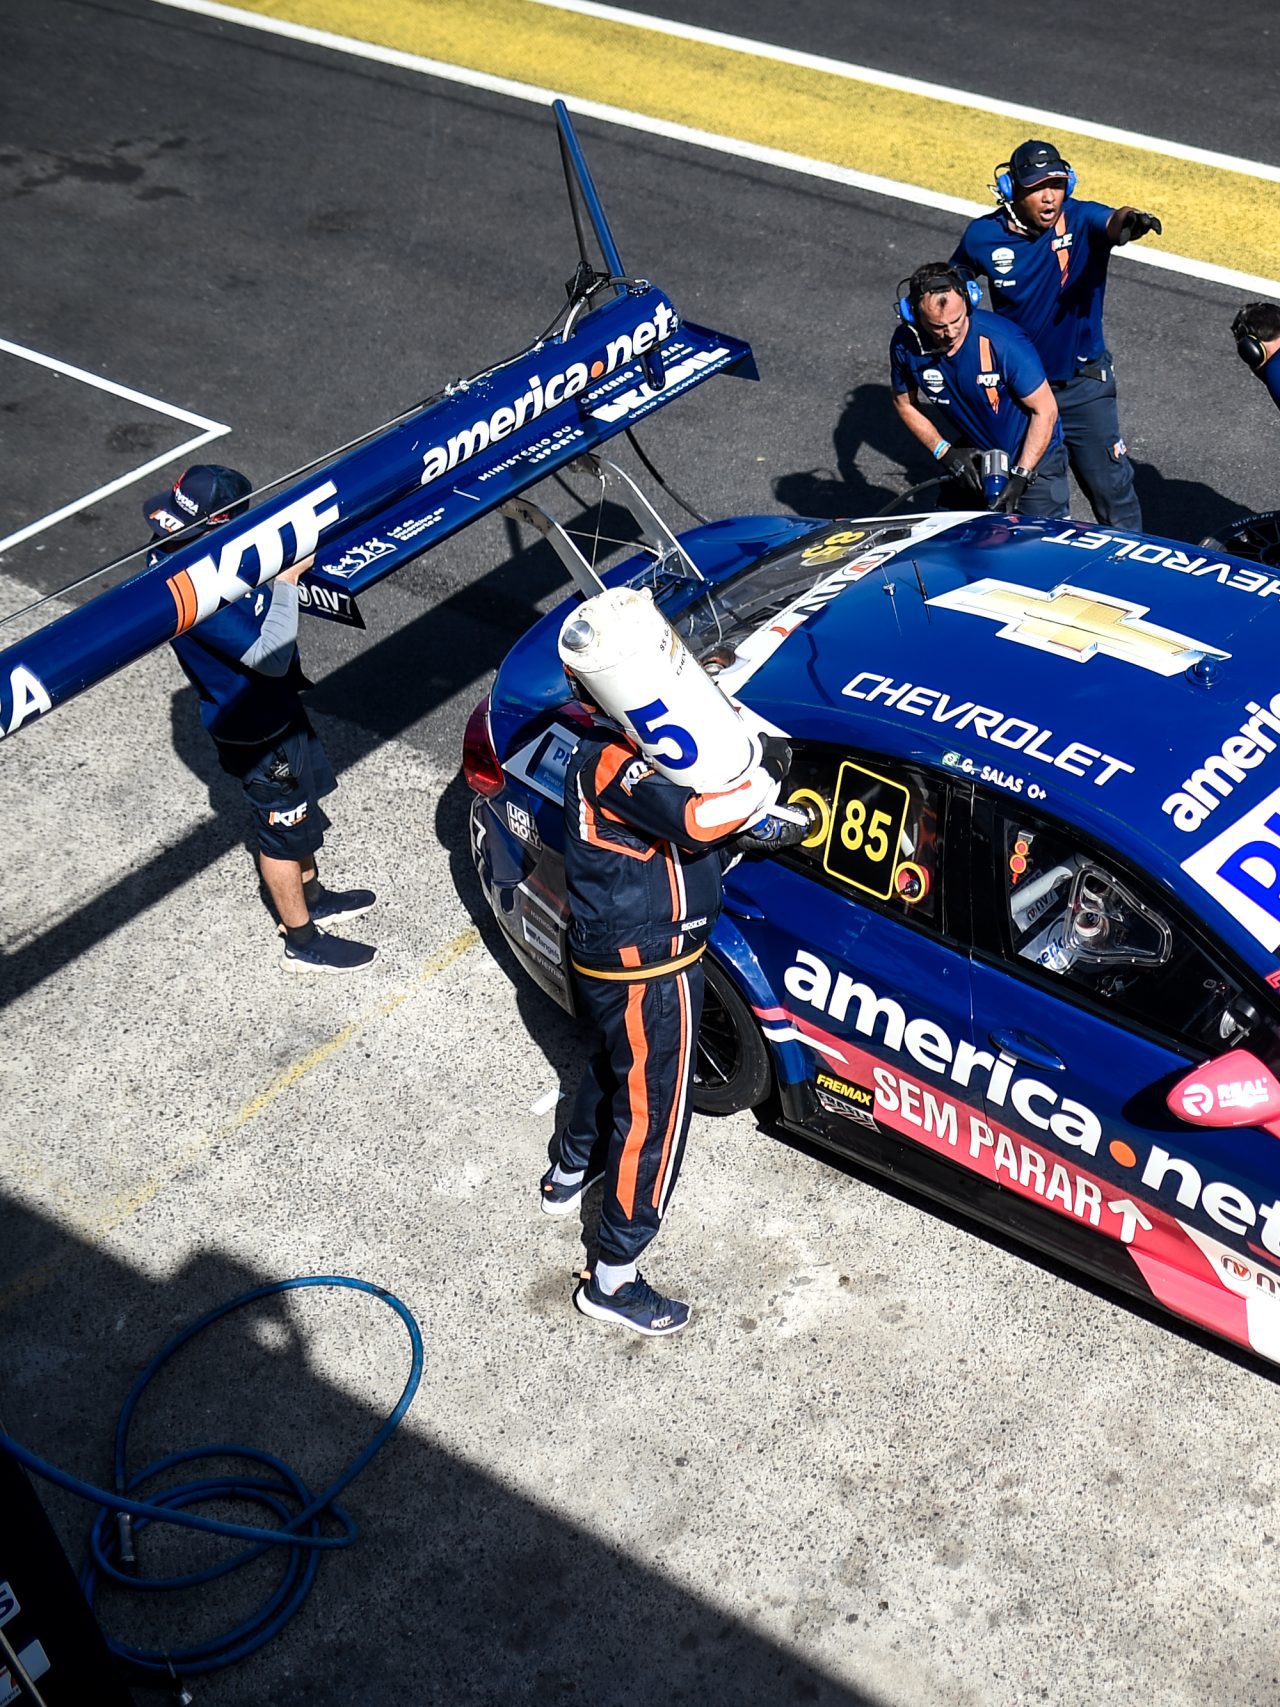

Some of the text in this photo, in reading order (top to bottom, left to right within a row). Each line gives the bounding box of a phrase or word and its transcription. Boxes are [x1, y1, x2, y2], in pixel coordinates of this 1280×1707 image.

[580, 371, 635, 404] GOVERNO
[478, 438, 551, 482] MINISTÉRIO
[528, 429, 585, 464] ESPORTE
[187, 480, 340, 626] KTF
[624, 698, 699, 770] 5
[841, 672, 1135, 787] CHEVROLET
[962, 758, 975, 775] G.
[980, 765, 1024, 793] SALAS
[268, 801, 308, 827] KTF
[508, 804, 538, 832] LIQUI
[840, 799, 890, 863] 85
[509, 818, 540, 846] MOLY
[816, 1073, 873, 1107] FREMAX
[871, 1066, 1102, 1227] SEM PARAR
